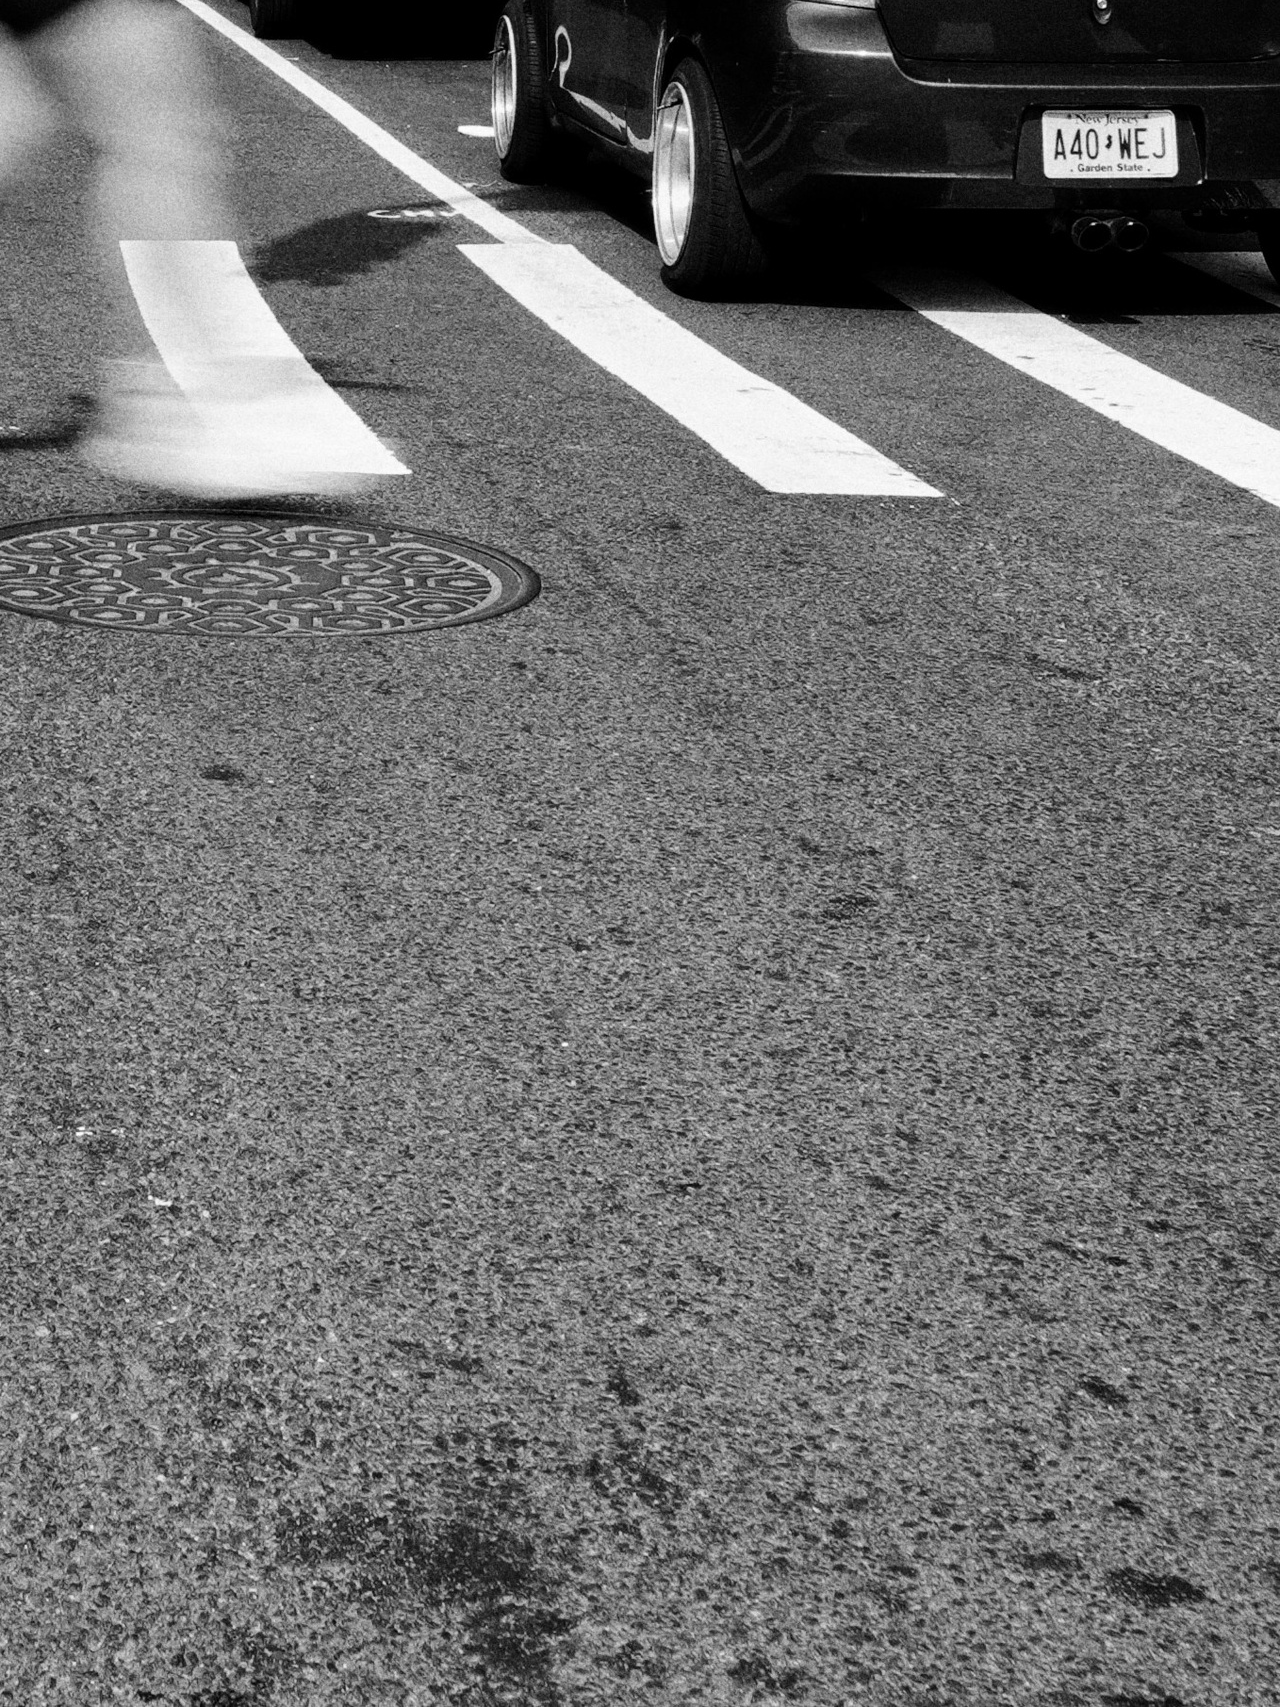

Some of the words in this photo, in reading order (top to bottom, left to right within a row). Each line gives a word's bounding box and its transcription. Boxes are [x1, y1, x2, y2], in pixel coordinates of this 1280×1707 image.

[1075, 113, 1103, 125] New
[1103, 113, 1140, 127] Jersey
[1117, 127, 1167, 160] WEJ
[1077, 163, 1113, 173] Garden
[1116, 162, 1144, 172] State
